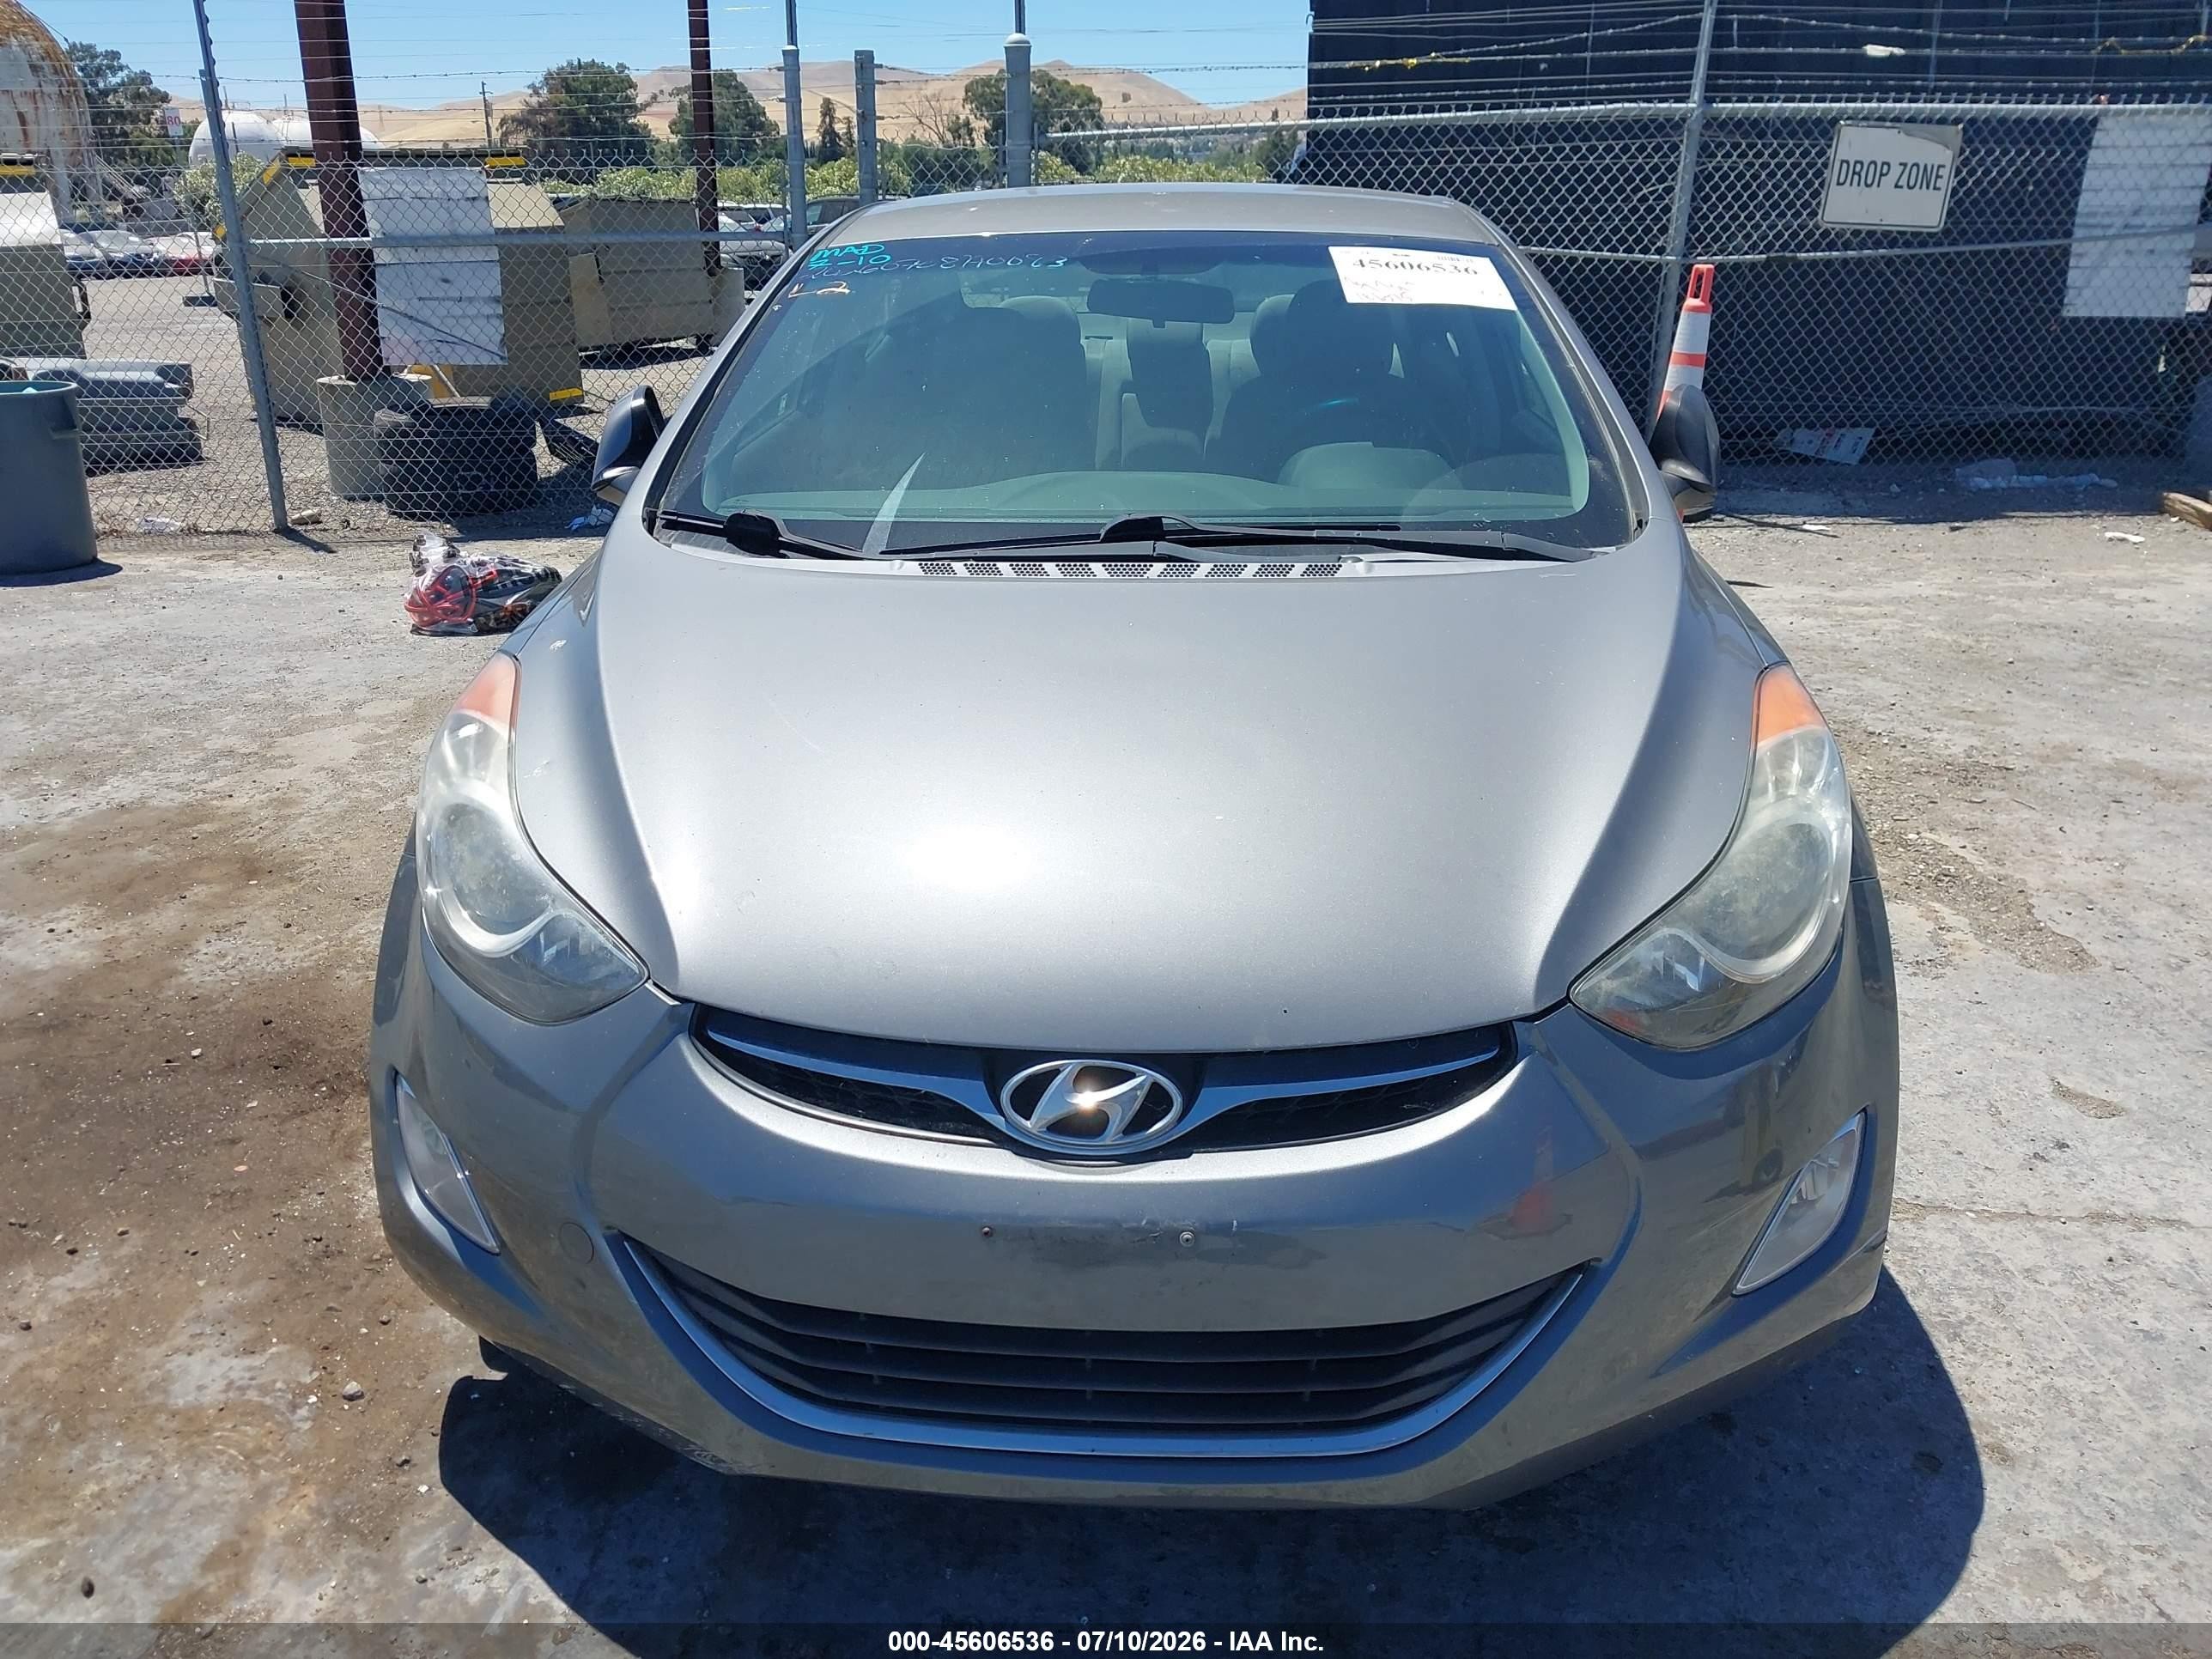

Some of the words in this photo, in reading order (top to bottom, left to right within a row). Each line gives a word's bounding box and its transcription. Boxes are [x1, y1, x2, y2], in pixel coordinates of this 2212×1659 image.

[167, 115, 181, 127] 80
[1836, 159, 1891, 188] DROP
[1893, 162, 1946, 191] ZONE
[1352, 258, 1478, 276] 45606536
